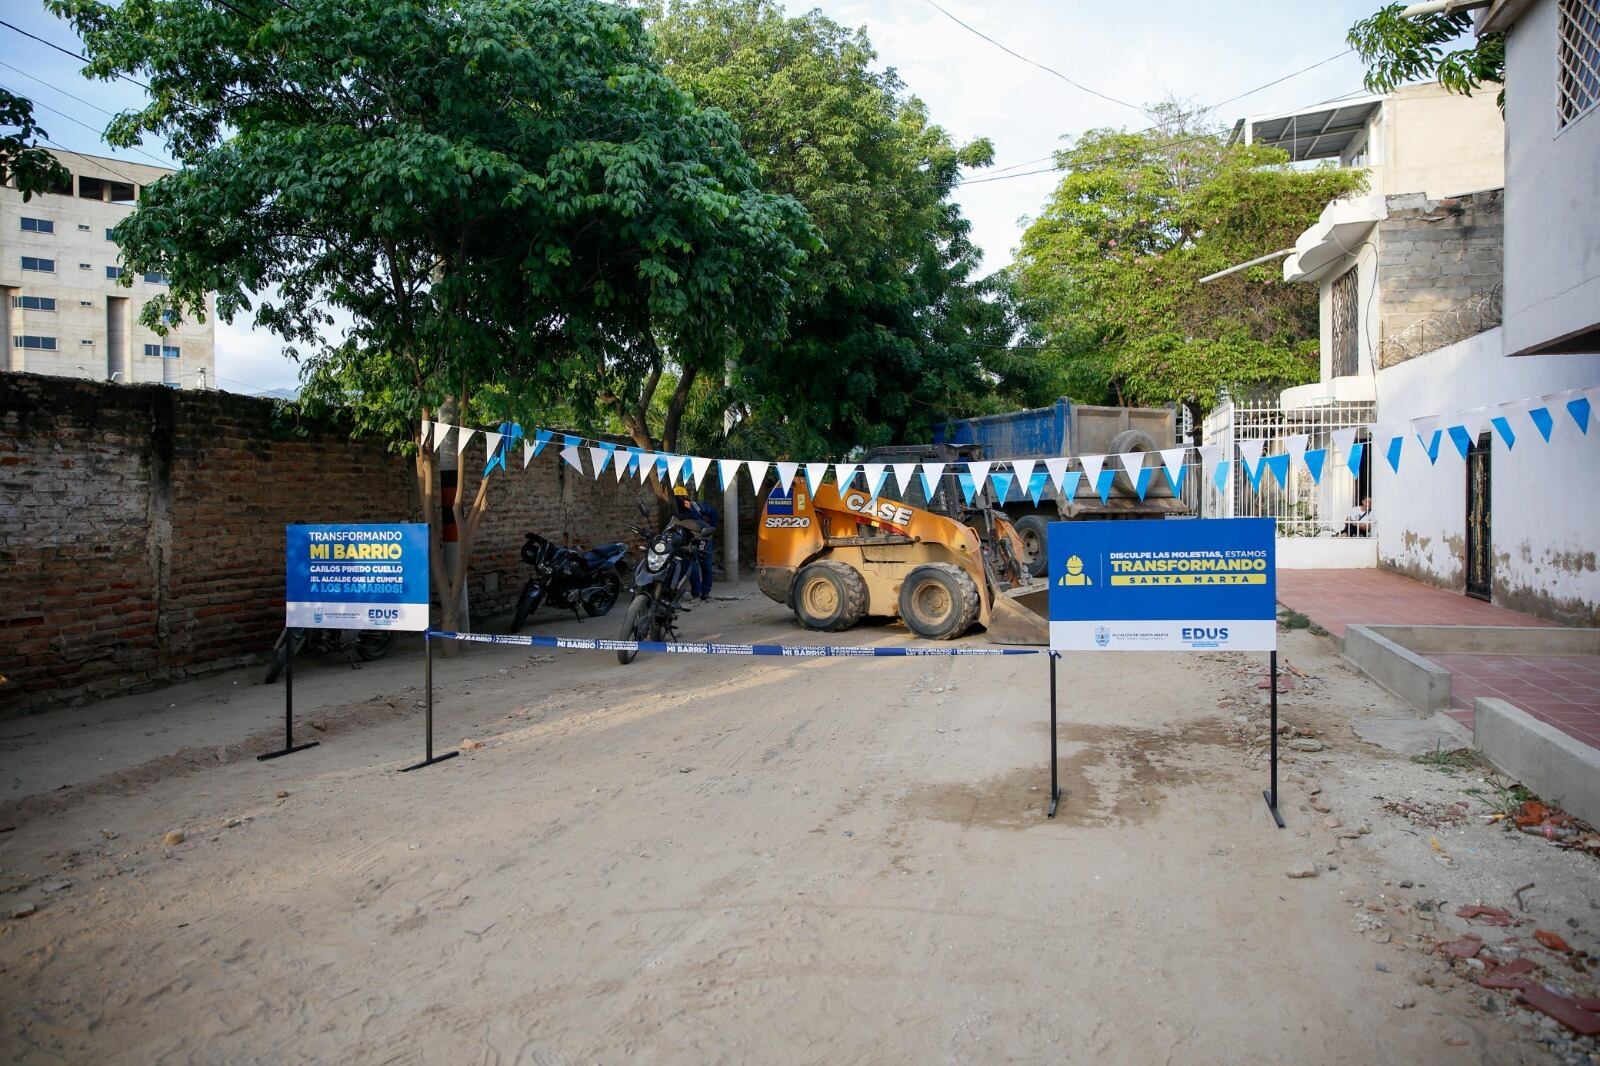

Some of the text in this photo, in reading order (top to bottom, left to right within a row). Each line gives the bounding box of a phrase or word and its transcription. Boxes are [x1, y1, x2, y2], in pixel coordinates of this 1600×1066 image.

[846, 493, 913, 526] CASE
[765, 517, 811, 528] SR220
[309, 531, 402, 541] TRANSFORMANDO
[310, 543, 402, 560] MI BARRIO
[1172, 551, 1224, 559] MOLESTIAS,
[1110, 558, 1266, 572] TRANSFORMANDO
[1130, 576, 1182, 584] SANTA
[310, 584, 403, 594] A LOS SAMARIOS!
[368, 609, 398, 619] EDUS
[1182, 628, 1228, 640] EDUS
